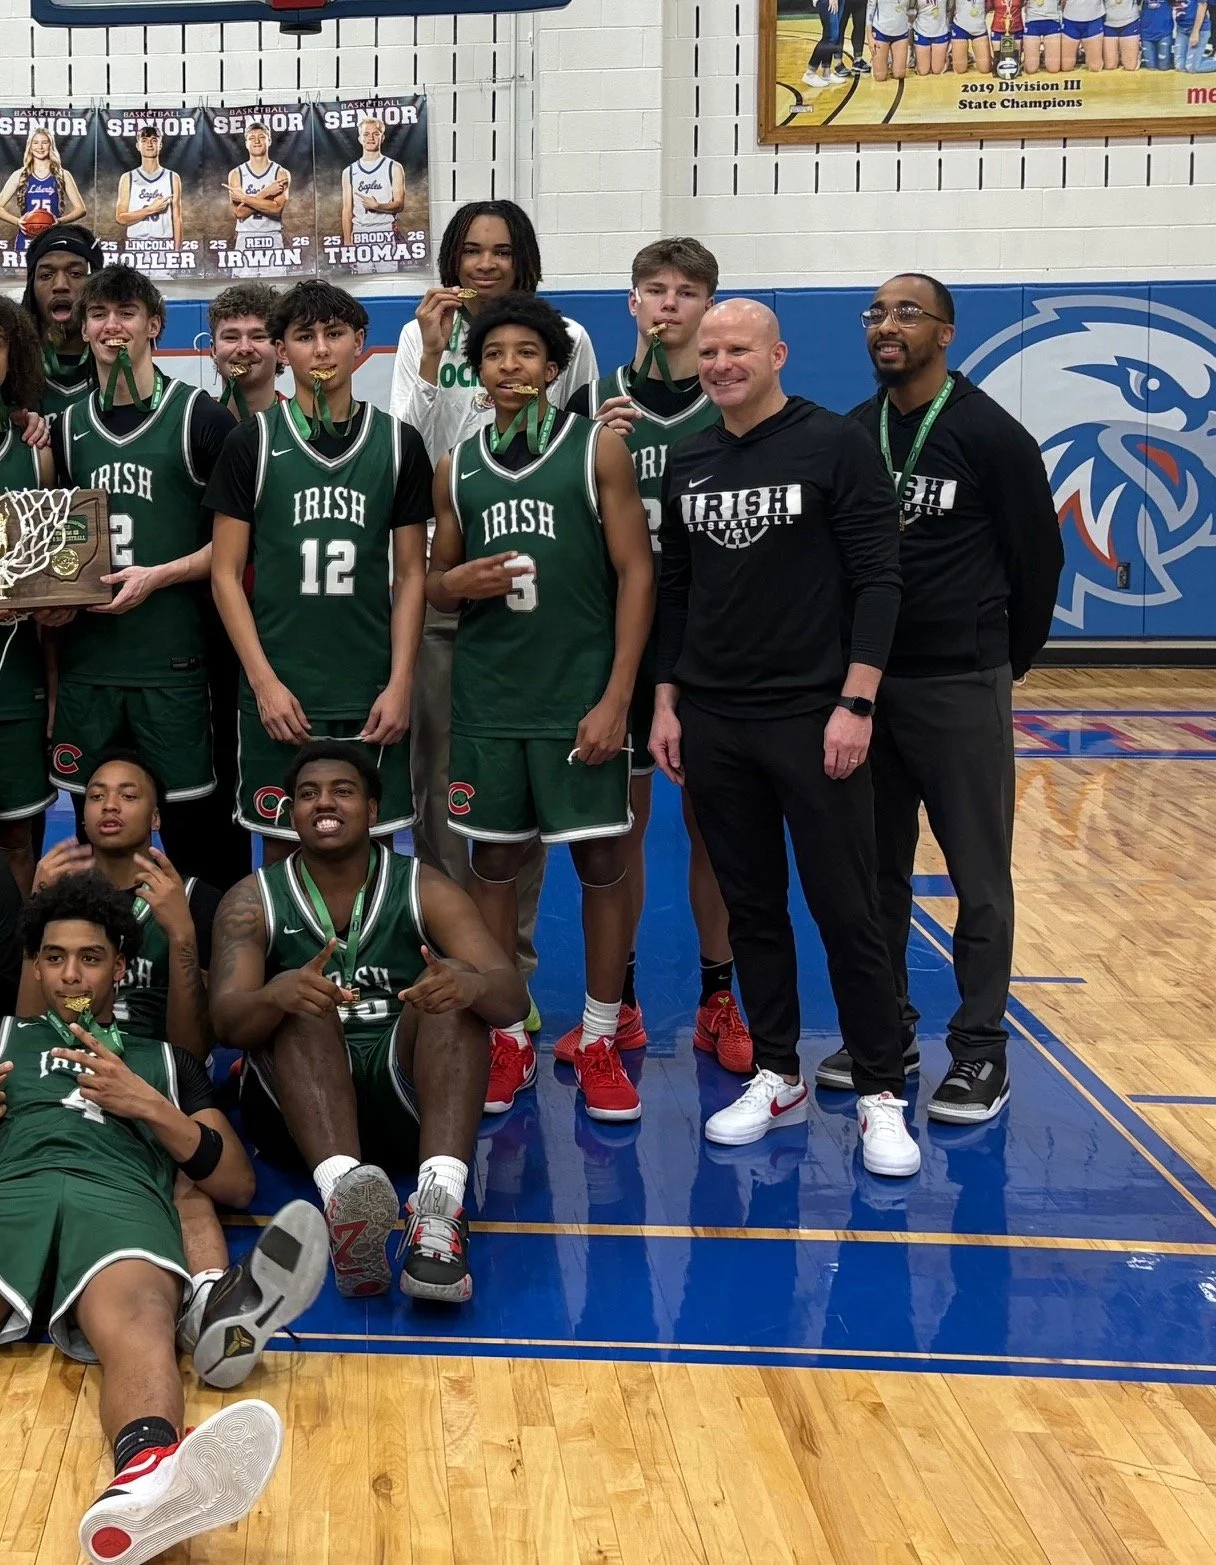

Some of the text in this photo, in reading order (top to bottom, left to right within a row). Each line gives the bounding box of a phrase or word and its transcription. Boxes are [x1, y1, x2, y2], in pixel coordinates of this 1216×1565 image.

[961, 80, 1081, 93] 2019 Division III
[229, 106, 288, 116] BASKETBALL
[341, 100, 401, 110] BASKETBALL
[958, 98, 1082, 109] State Champions
[124, 110, 181, 118] BASKETBALL
[101, 240, 199, 251] 25 LINCOLN 26
[209, 236, 310, 250] 25 REID 26
[324, 231, 425, 245] 25 BRODY 26
[103, 252, 196, 269] HOLLER
[217, 249, 302, 268] IRWIN
[324, 242, 426, 264] THOMAS
[90, 462, 153, 502] IRISH
[293, 487, 367, 529] IRISH
[688, 486, 789, 522] IRISH
[482, 498, 557, 546] IRISH
[687, 515, 794, 533] BASKETBALL
[300, 538, 356, 596] 12
[504, 555, 539, 613] 3
